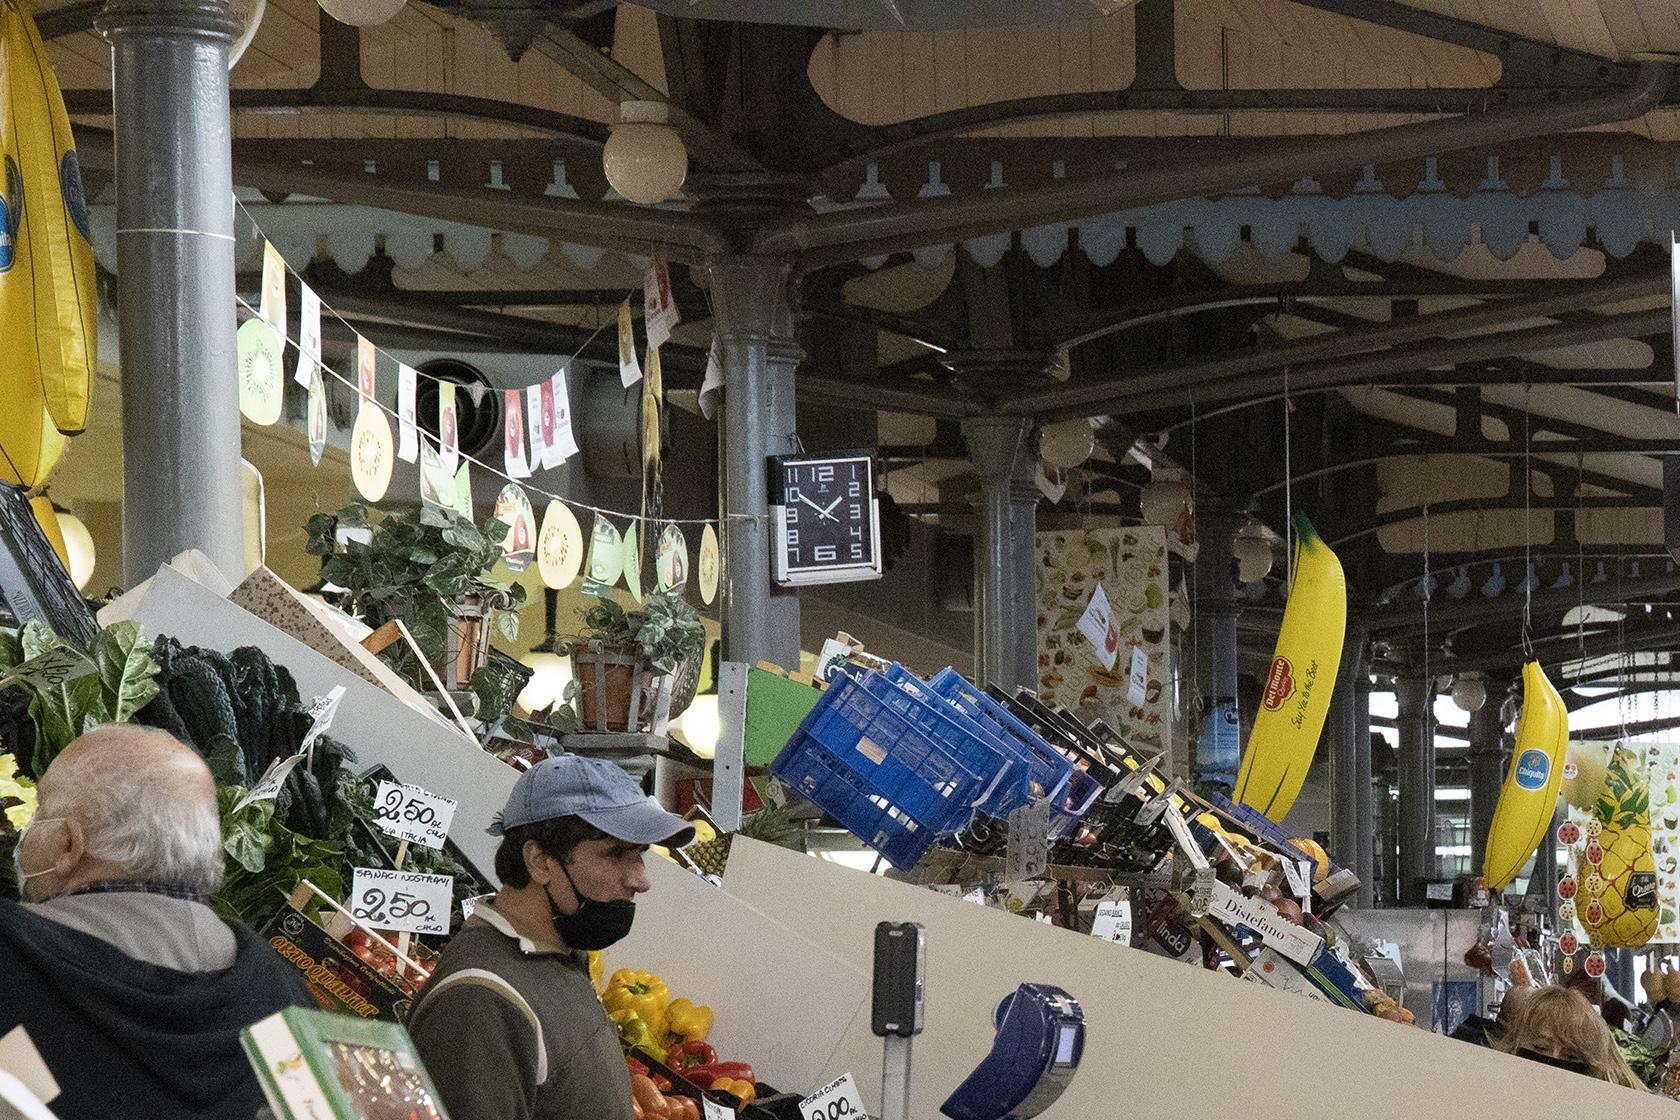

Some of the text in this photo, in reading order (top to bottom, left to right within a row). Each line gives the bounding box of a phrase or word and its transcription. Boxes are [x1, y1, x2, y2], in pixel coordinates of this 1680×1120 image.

[811, 465, 835, 482] 12
[401, 831, 427, 844] ITALIA
[401, 873, 450, 887] NOSTRANI
[1223, 898, 1285, 941] Distefano
